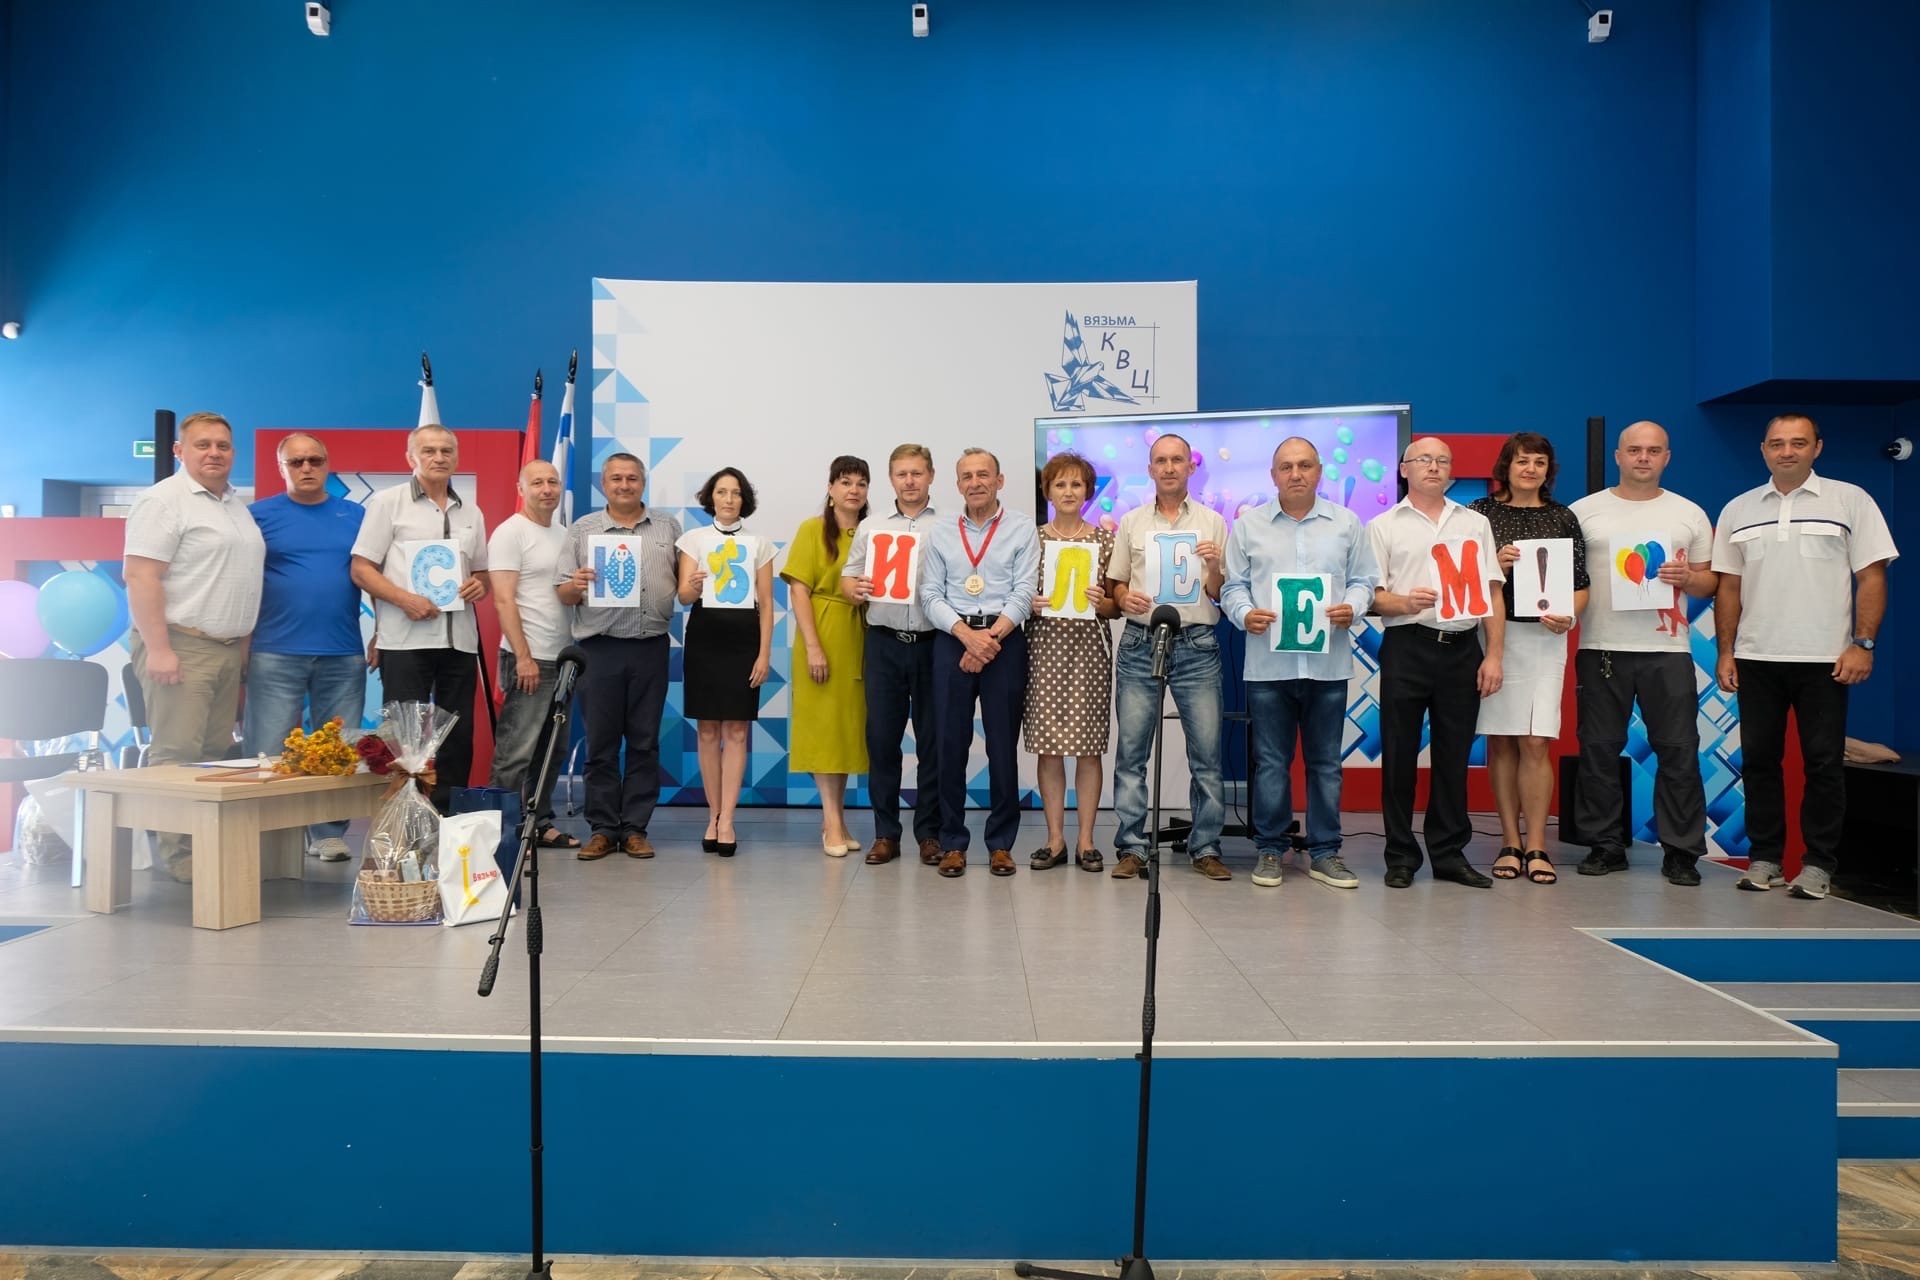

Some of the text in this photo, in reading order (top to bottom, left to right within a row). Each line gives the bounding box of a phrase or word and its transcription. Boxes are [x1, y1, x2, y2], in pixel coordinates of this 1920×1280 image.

[1084, 316, 1136, 326] ВЯЗЬМА
[411, 545, 458, 606] С
[594, 544, 636, 599] Ю
[872, 533, 916, 599] И
[1048, 547, 1090, 613] Л
[1431, 540, 1489, 619] М
[1275, 576, 1325, 652] Е
